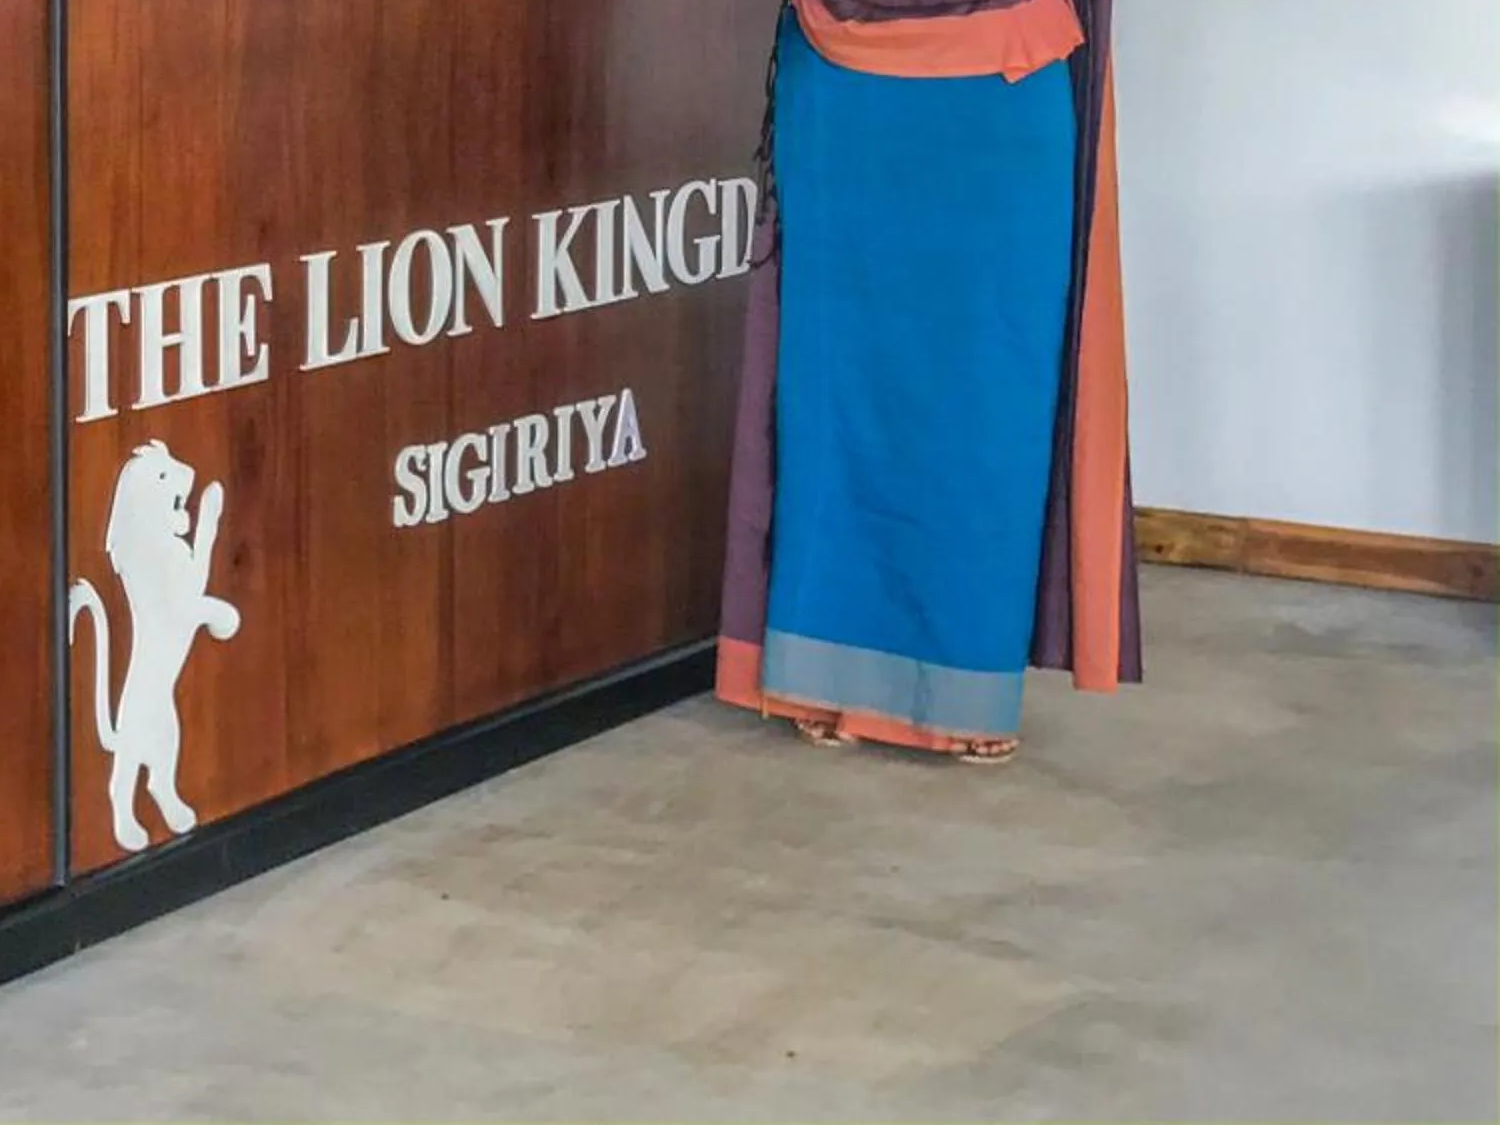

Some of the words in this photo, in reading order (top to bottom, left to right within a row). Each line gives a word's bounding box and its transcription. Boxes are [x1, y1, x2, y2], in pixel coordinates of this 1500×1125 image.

[68, 263, 273, 423] THE
[299, 216, 510, 372] LION
[393, 388, 647, 528] SIGIRIYA
